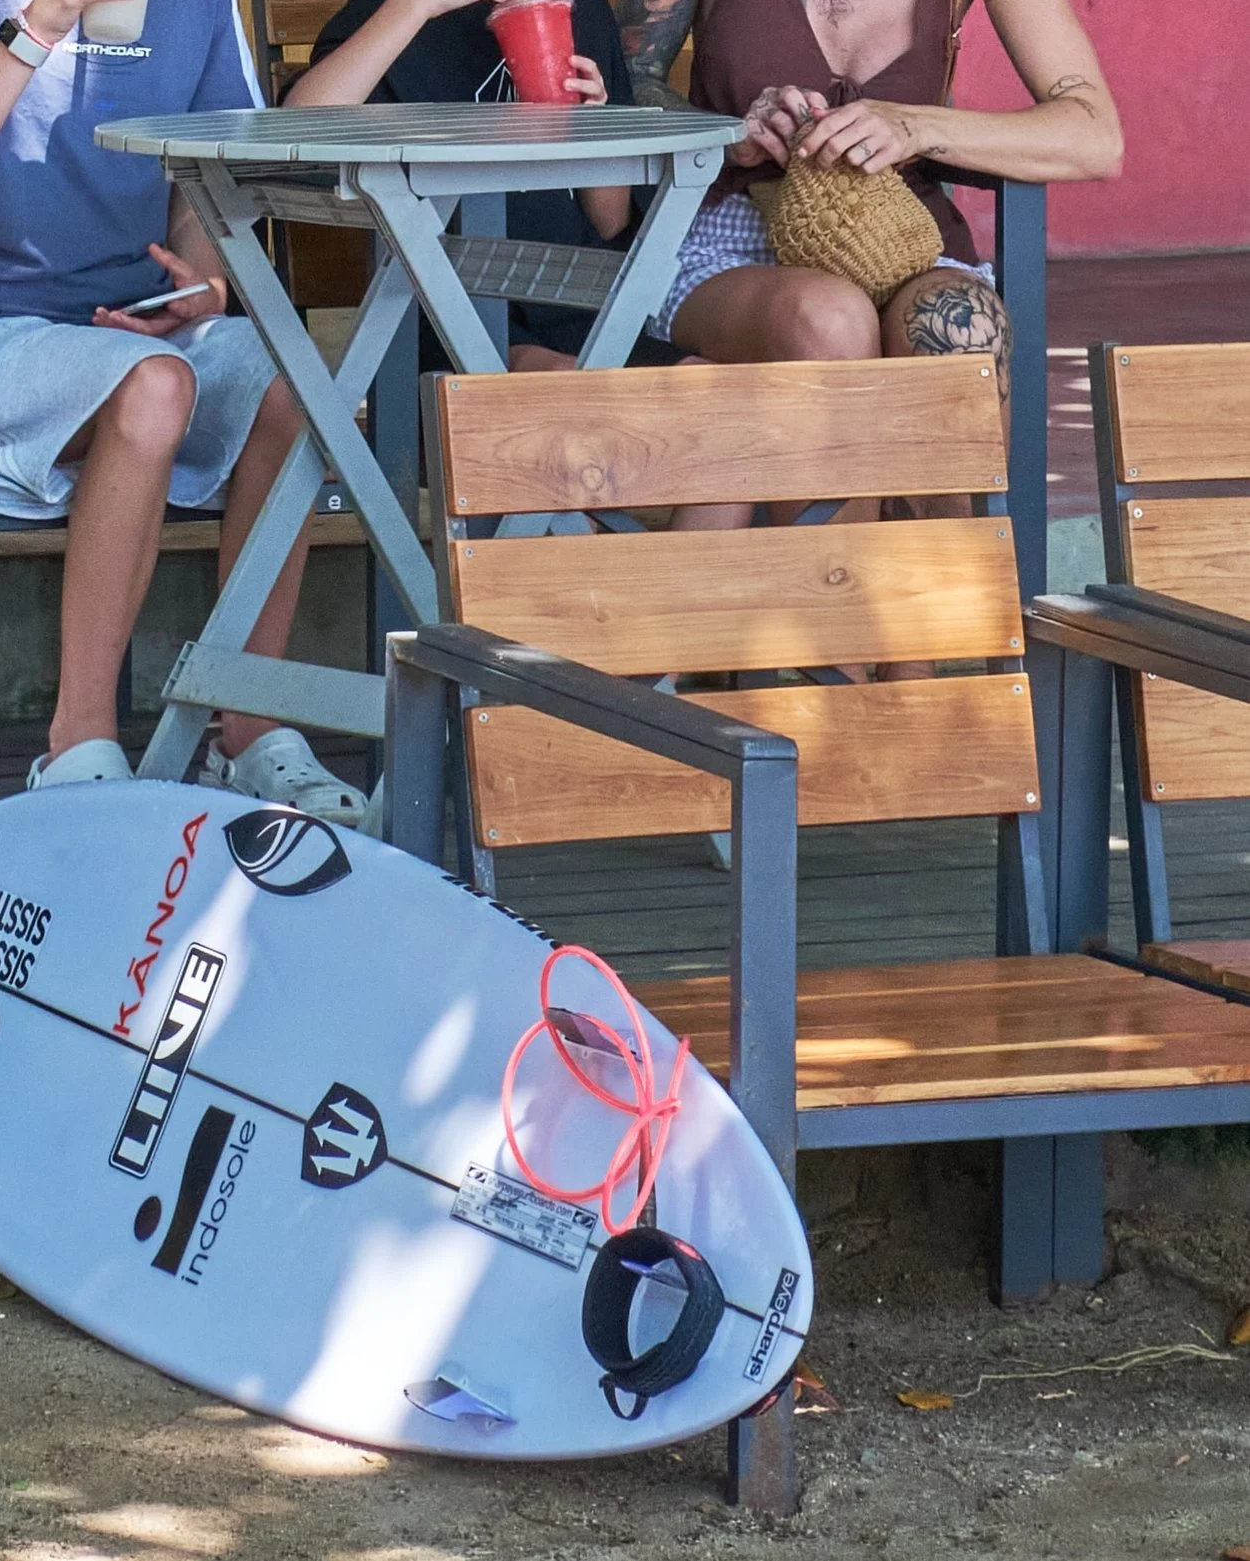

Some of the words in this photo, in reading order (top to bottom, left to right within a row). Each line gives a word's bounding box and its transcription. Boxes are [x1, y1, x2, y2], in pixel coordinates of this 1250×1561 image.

[62, 42, 152, 57] NORTHCOAST
[112, 812, 209, 1036] KĀNOA
[180, 1118, 258, 1286] indosole
[750, 1272, 796, 1377] sharpeye
